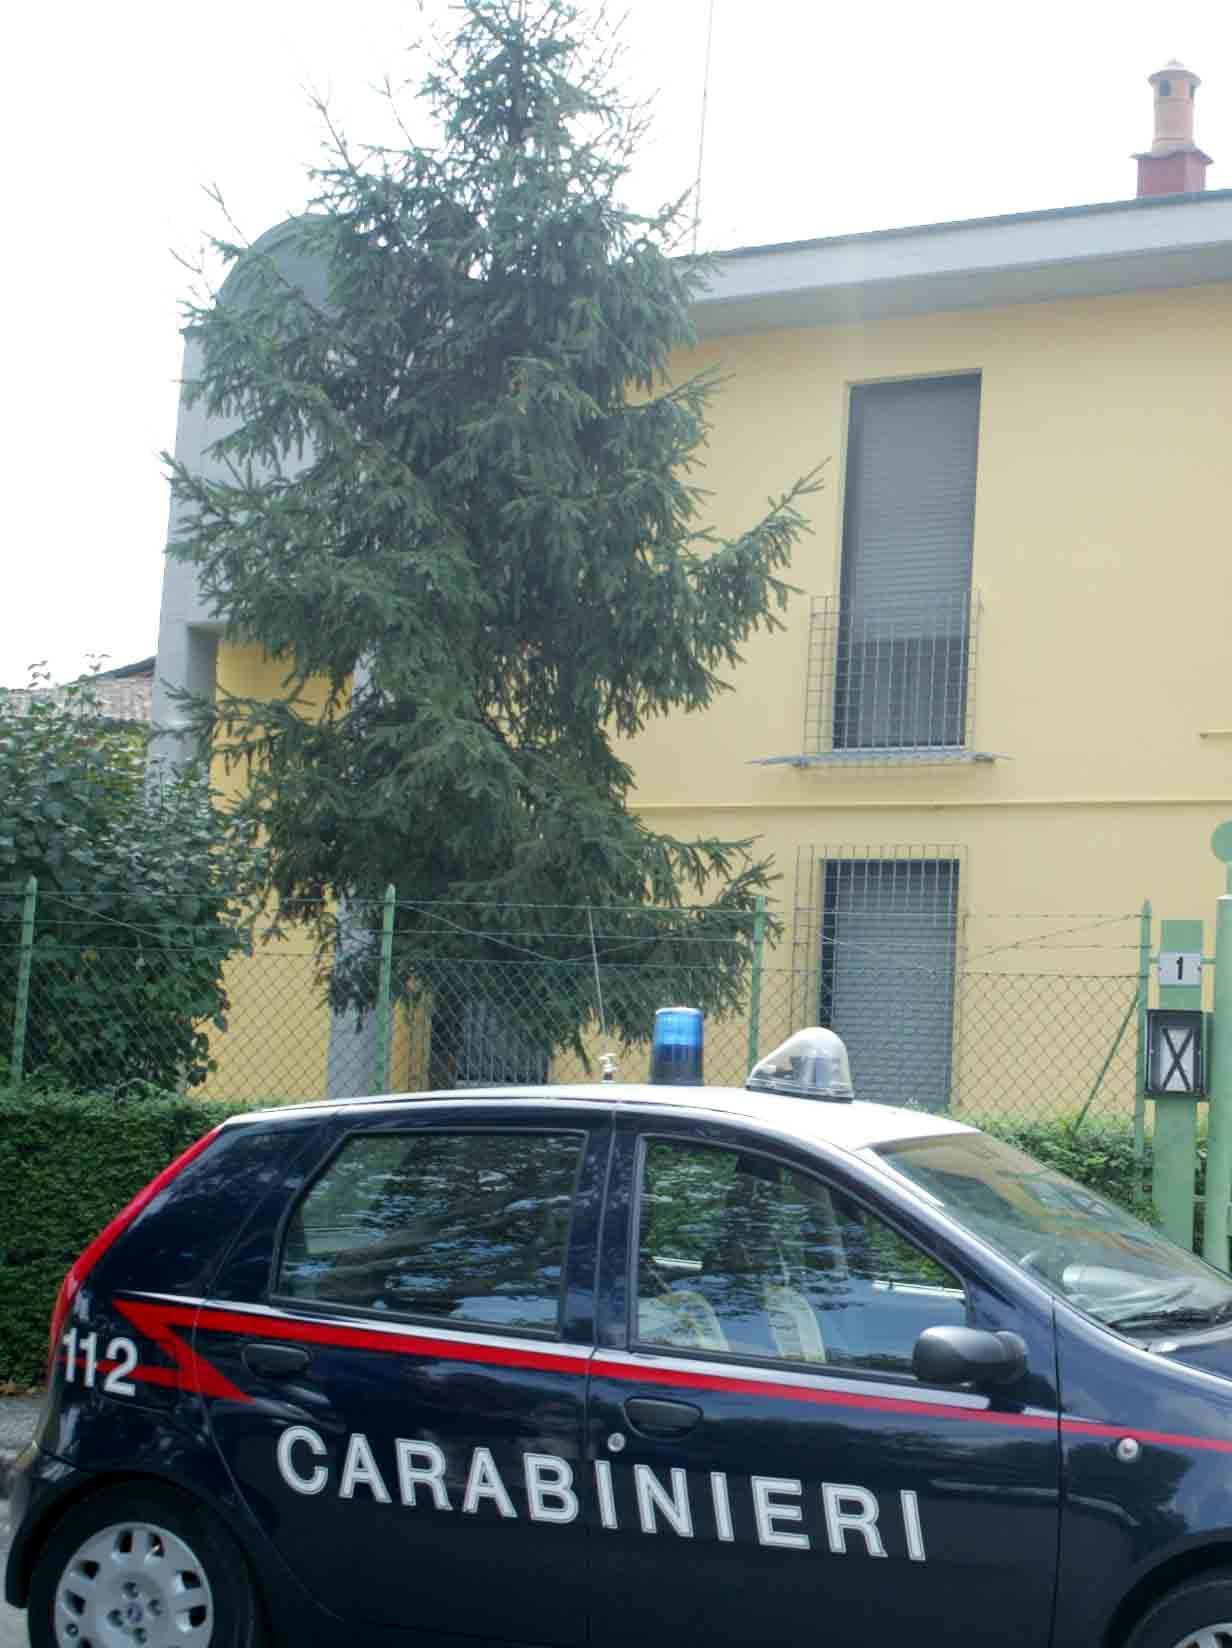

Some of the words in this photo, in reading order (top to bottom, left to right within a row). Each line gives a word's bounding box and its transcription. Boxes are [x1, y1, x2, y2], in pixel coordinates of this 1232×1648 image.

[1175, 955, 1184, 981] 1
[62, 1327, 139, 1398] 112
[276, 1423, 927, 1561] CARABINIERI
